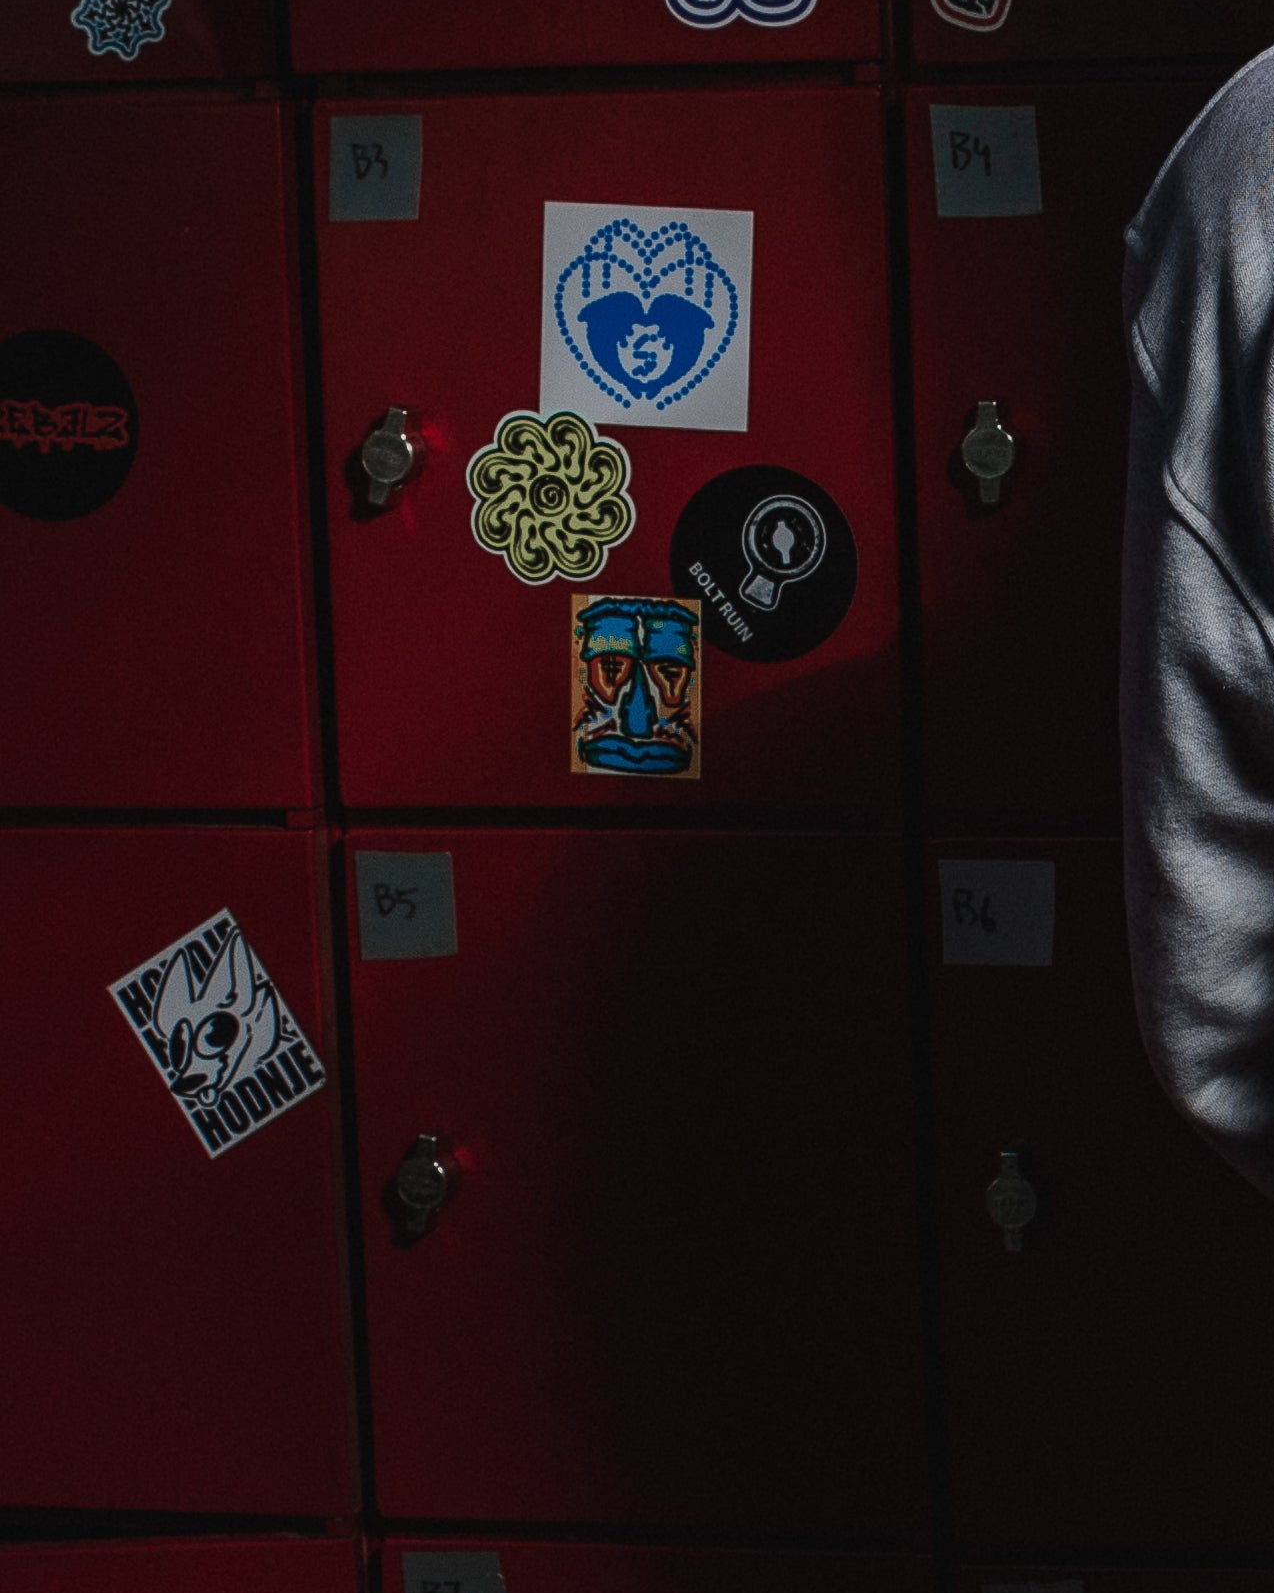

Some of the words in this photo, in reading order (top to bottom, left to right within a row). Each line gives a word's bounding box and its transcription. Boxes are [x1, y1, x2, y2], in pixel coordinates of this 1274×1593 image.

[351, 143, 389, 181] B3
[949, 130, 993, 177] B4
[688, 561, 726, 604] BOLT
[718, 601, 755, 643] RUIN
[372, 882, 419, 920] B5
[953, 887, 997, 933] B6
